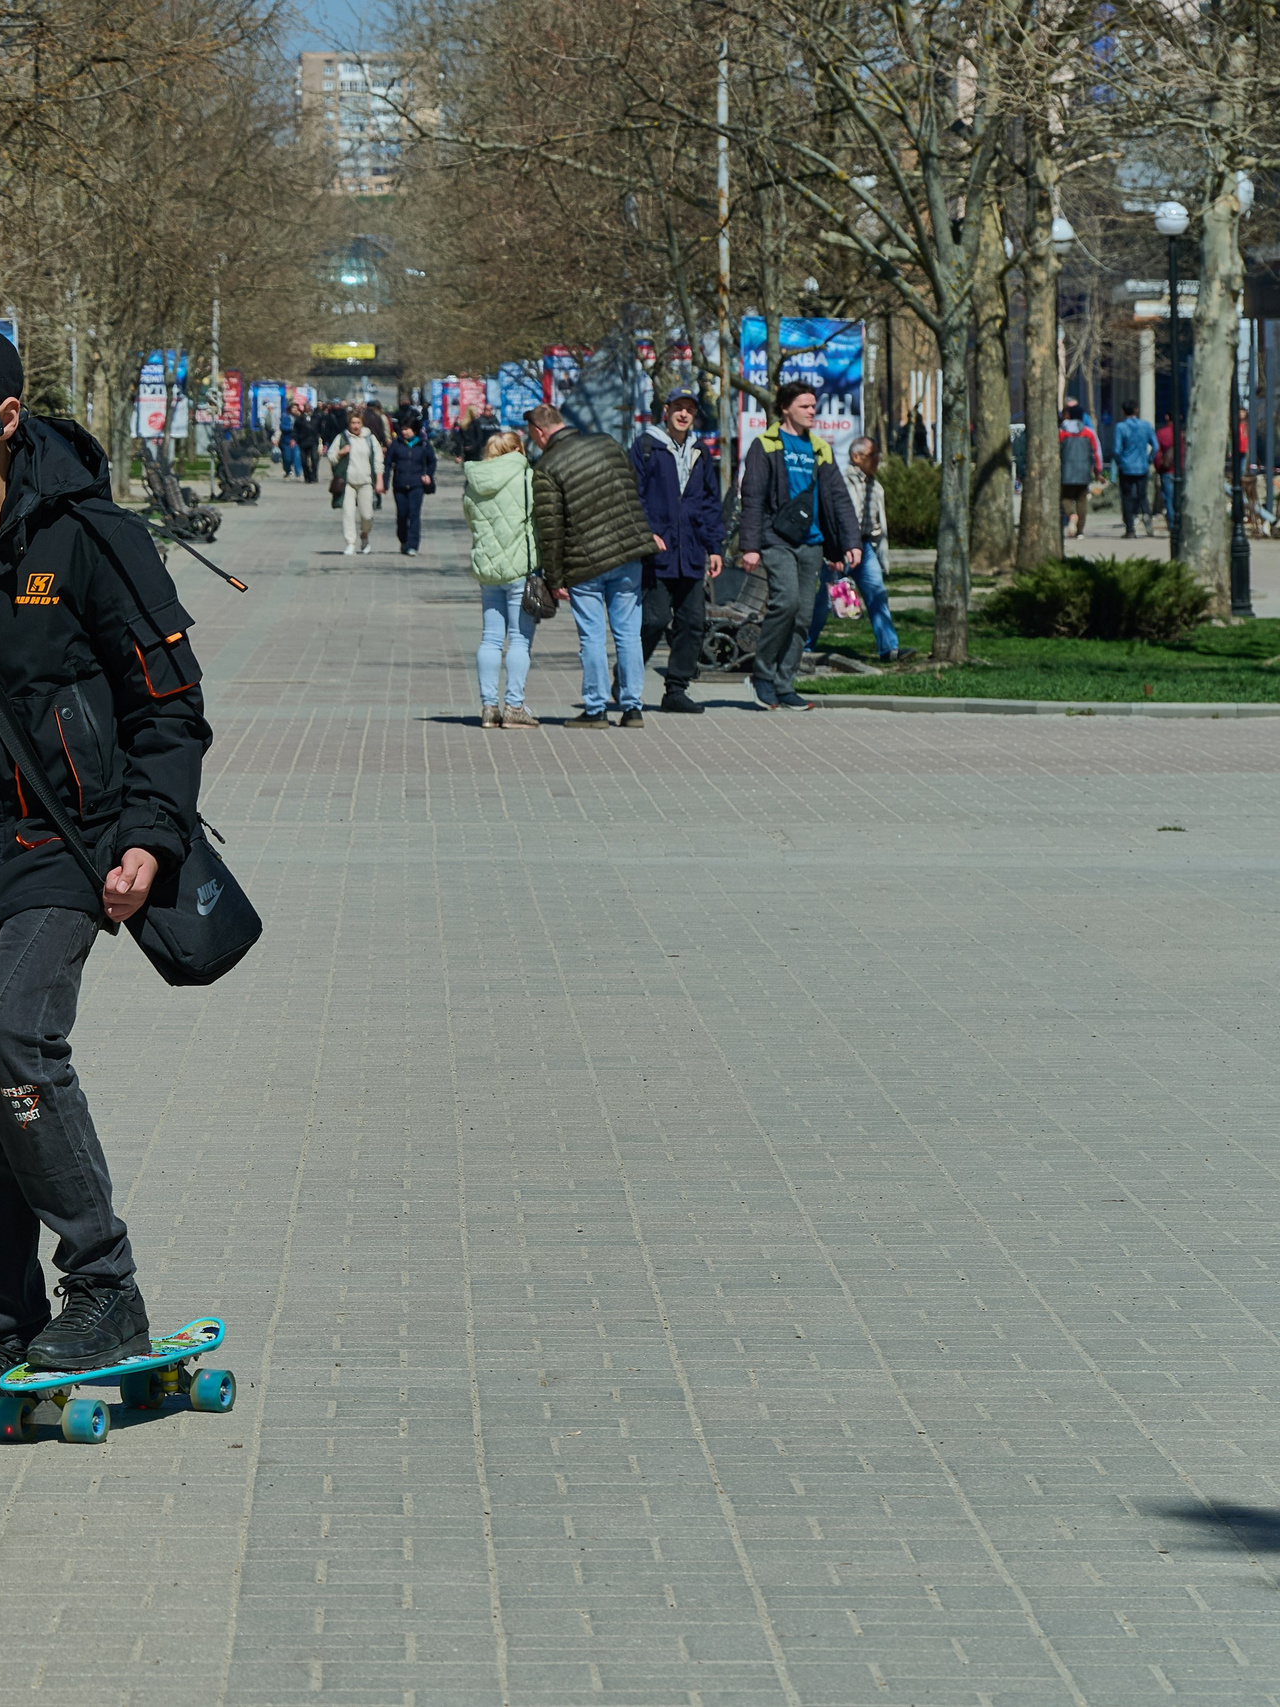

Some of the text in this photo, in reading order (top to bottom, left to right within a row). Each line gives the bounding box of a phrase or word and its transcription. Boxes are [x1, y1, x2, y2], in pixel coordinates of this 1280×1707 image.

[749, 350, 829, 367] МКВА
[197, 878, 219, 904] NIKE
[18, 1085, 35, 1095] JUST
[23, 1097, 33, 1107] TO
